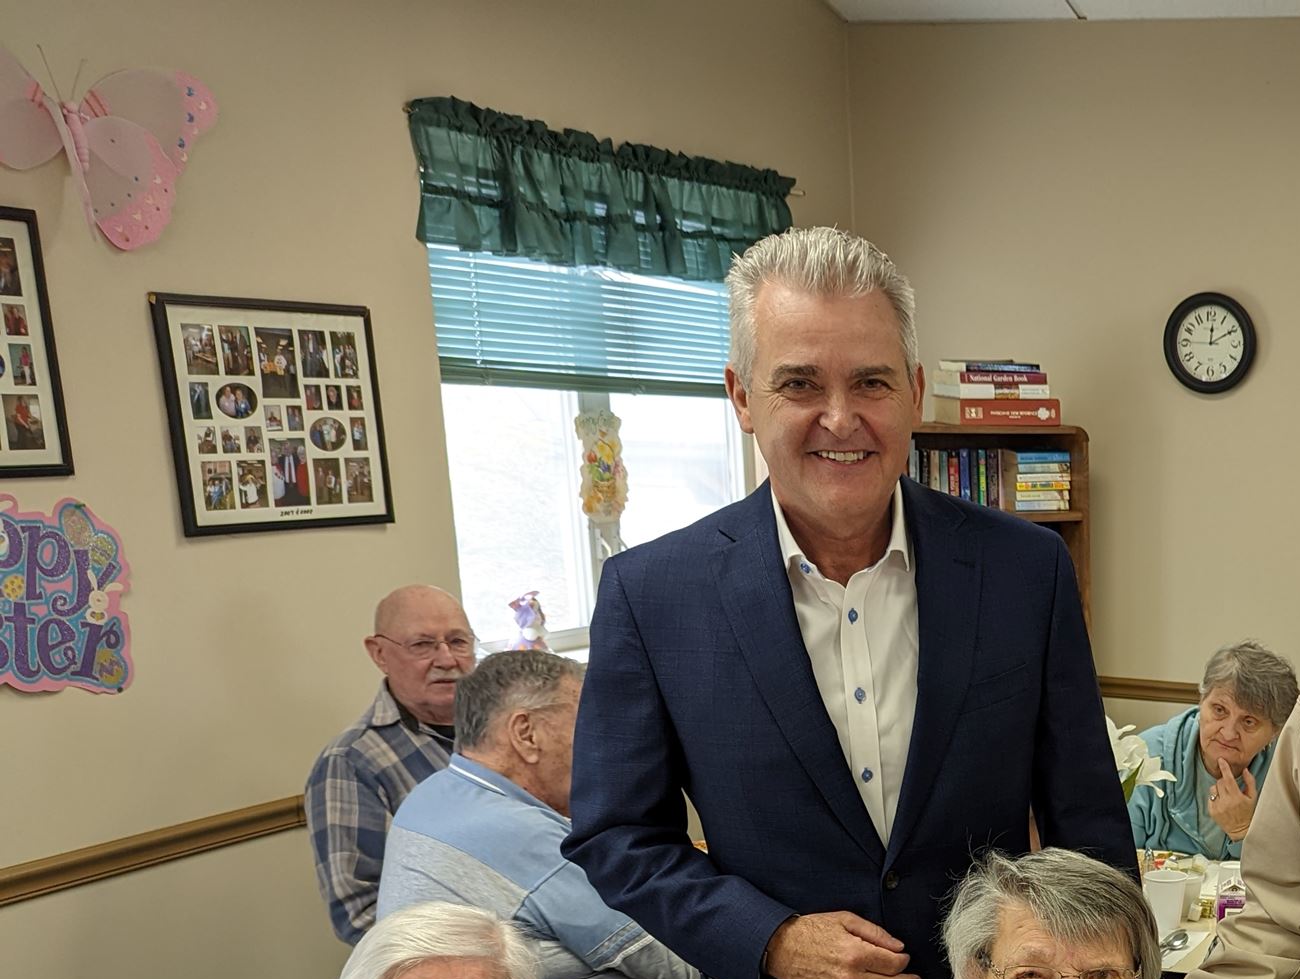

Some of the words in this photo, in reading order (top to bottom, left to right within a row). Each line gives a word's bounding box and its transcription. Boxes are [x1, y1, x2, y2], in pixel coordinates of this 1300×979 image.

[1206, 310, 1217, 322] 12
[1206, 365, 1214, 377] 6
[970, 374, 992, 382] National
[1014, 375, 1028, 383] Book
[0, 601, 121, 682] ter
